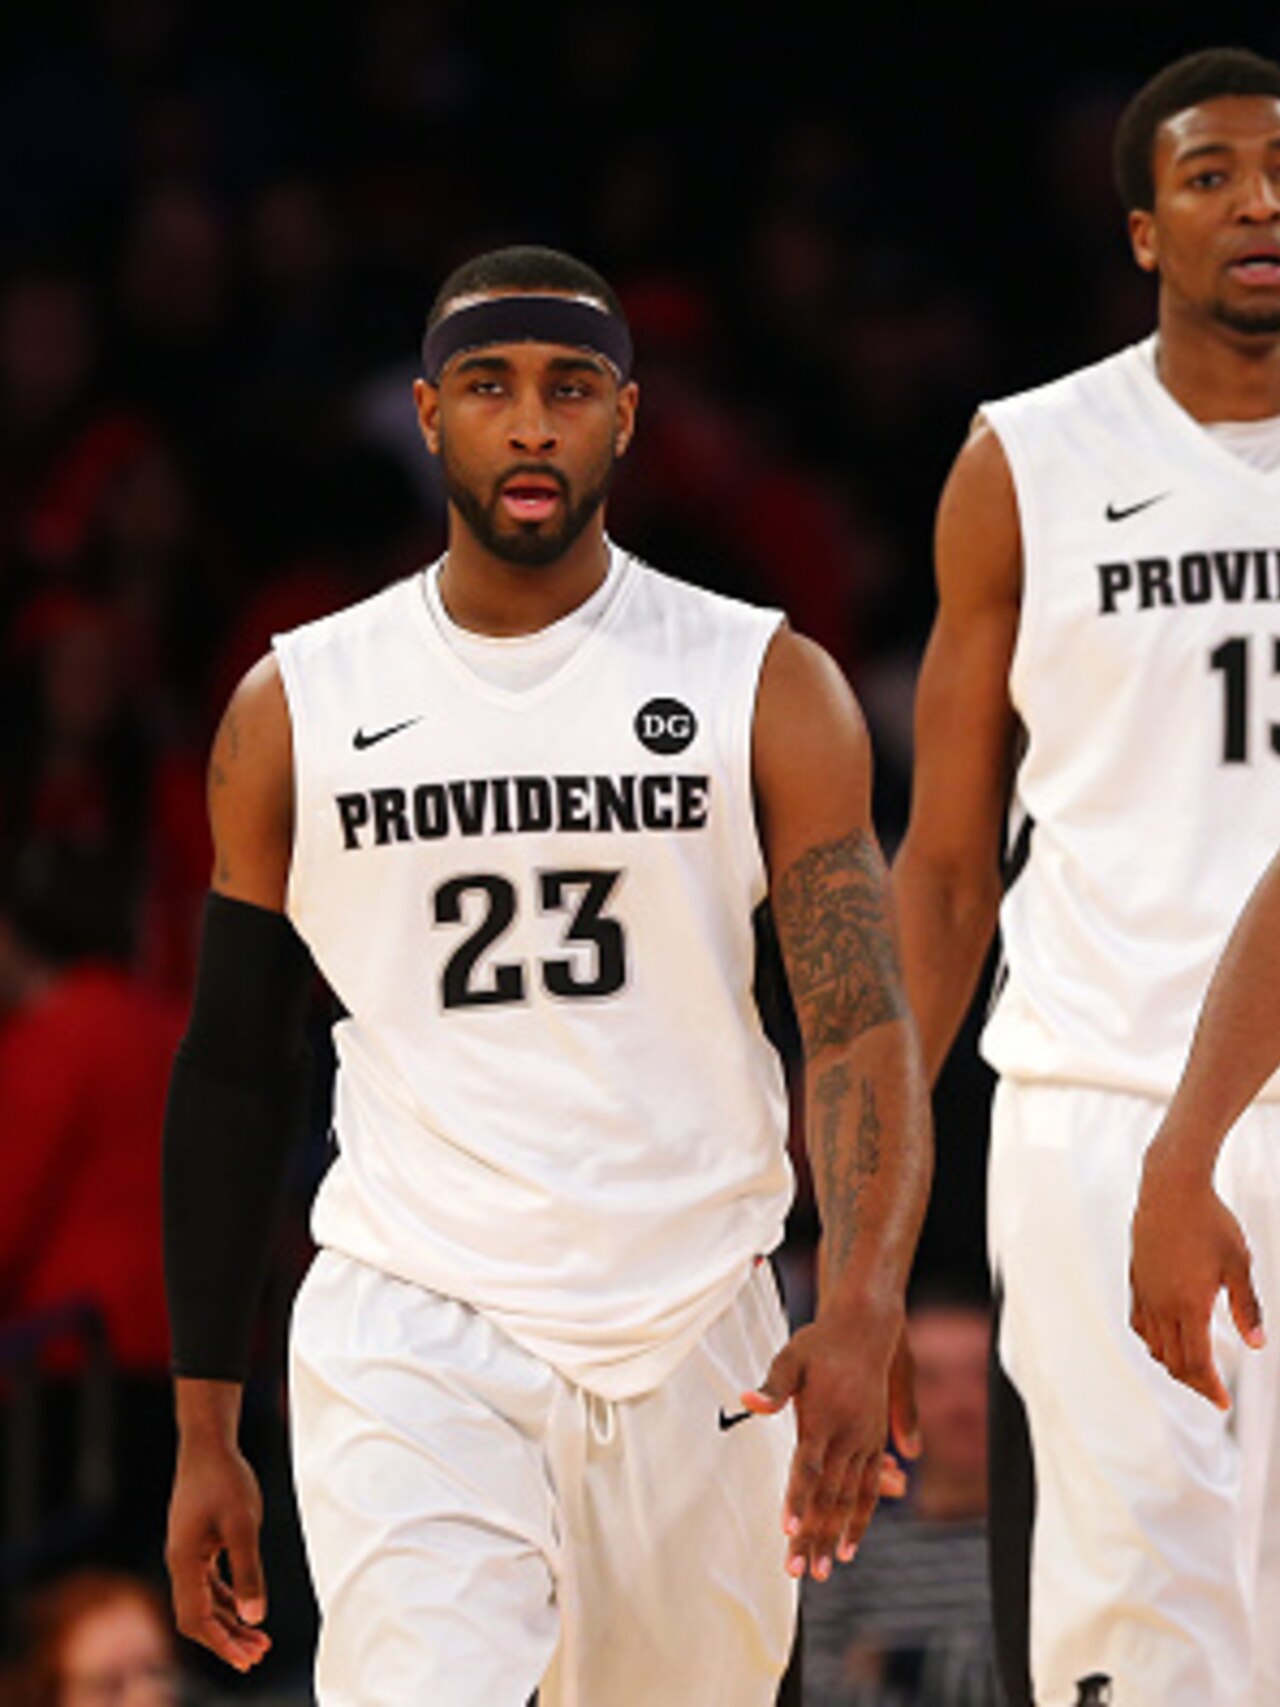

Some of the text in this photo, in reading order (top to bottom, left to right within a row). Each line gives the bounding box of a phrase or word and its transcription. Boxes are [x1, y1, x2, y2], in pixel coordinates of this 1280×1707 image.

[642, 713, 691, 739] DG
[335, 774, 710, 851] PROVIDENCE
[431, 867, 632, 1014] 23
